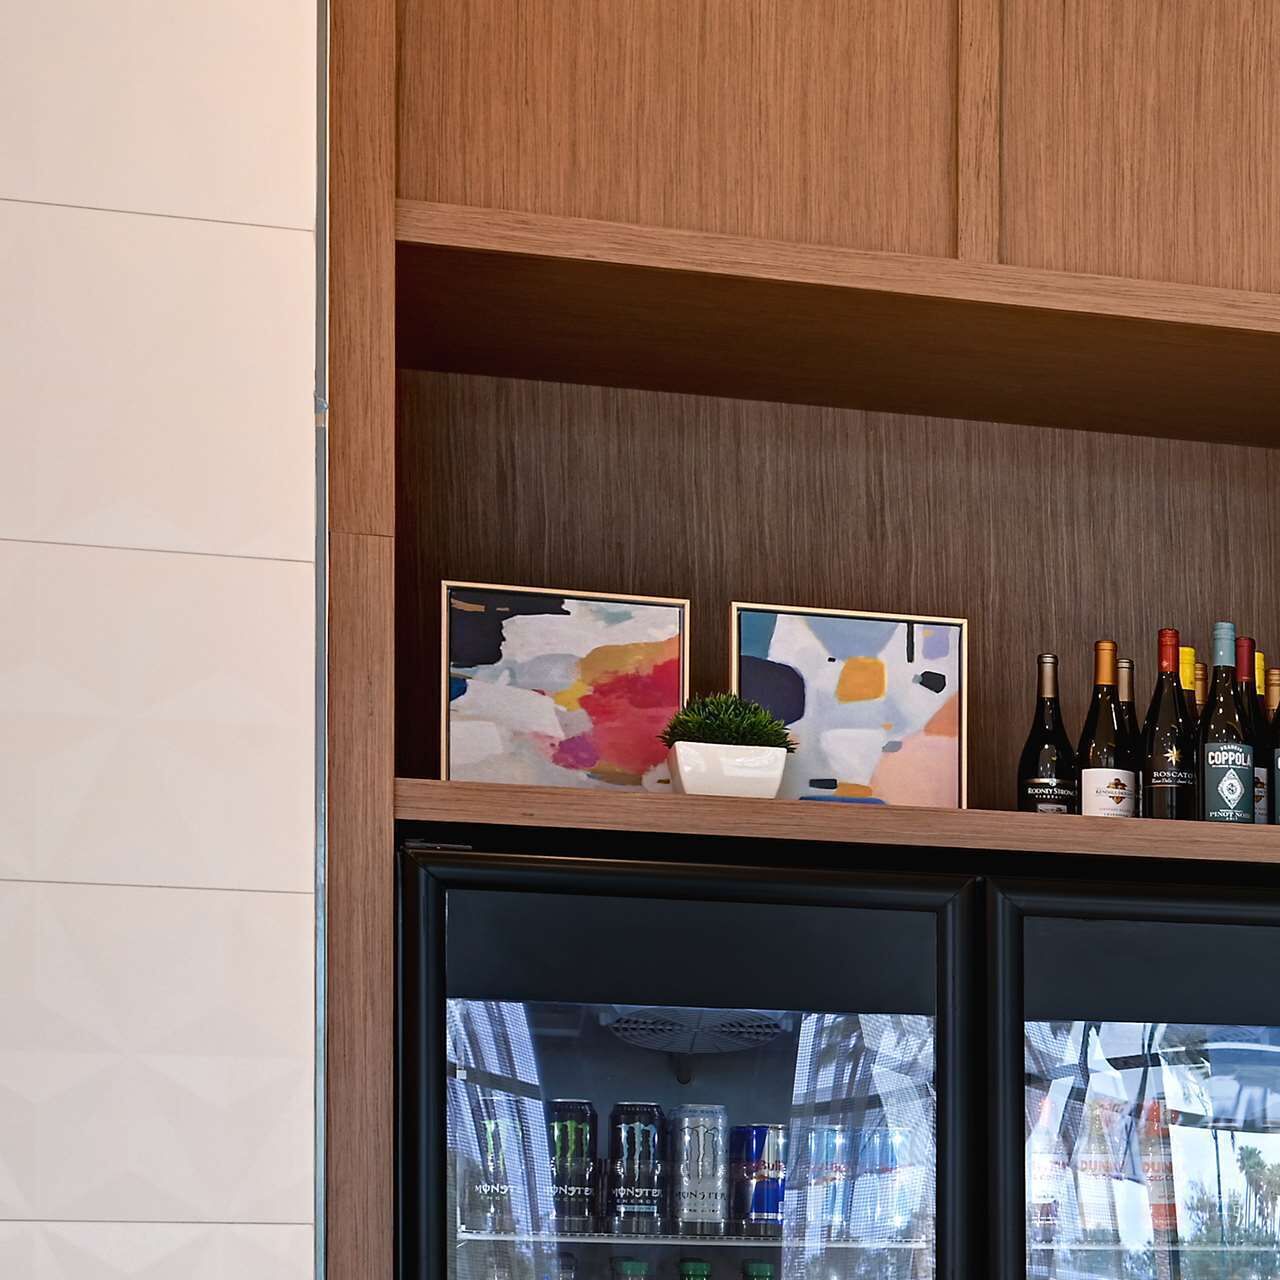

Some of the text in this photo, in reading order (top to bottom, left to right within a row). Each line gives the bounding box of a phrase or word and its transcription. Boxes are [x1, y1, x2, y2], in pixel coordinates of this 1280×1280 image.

[1153, 771, 1193, 779] ROSCATO
[1028, 787, 1053, 795] RODNEY
[612, 1187, 663, 1198] MONSTER
